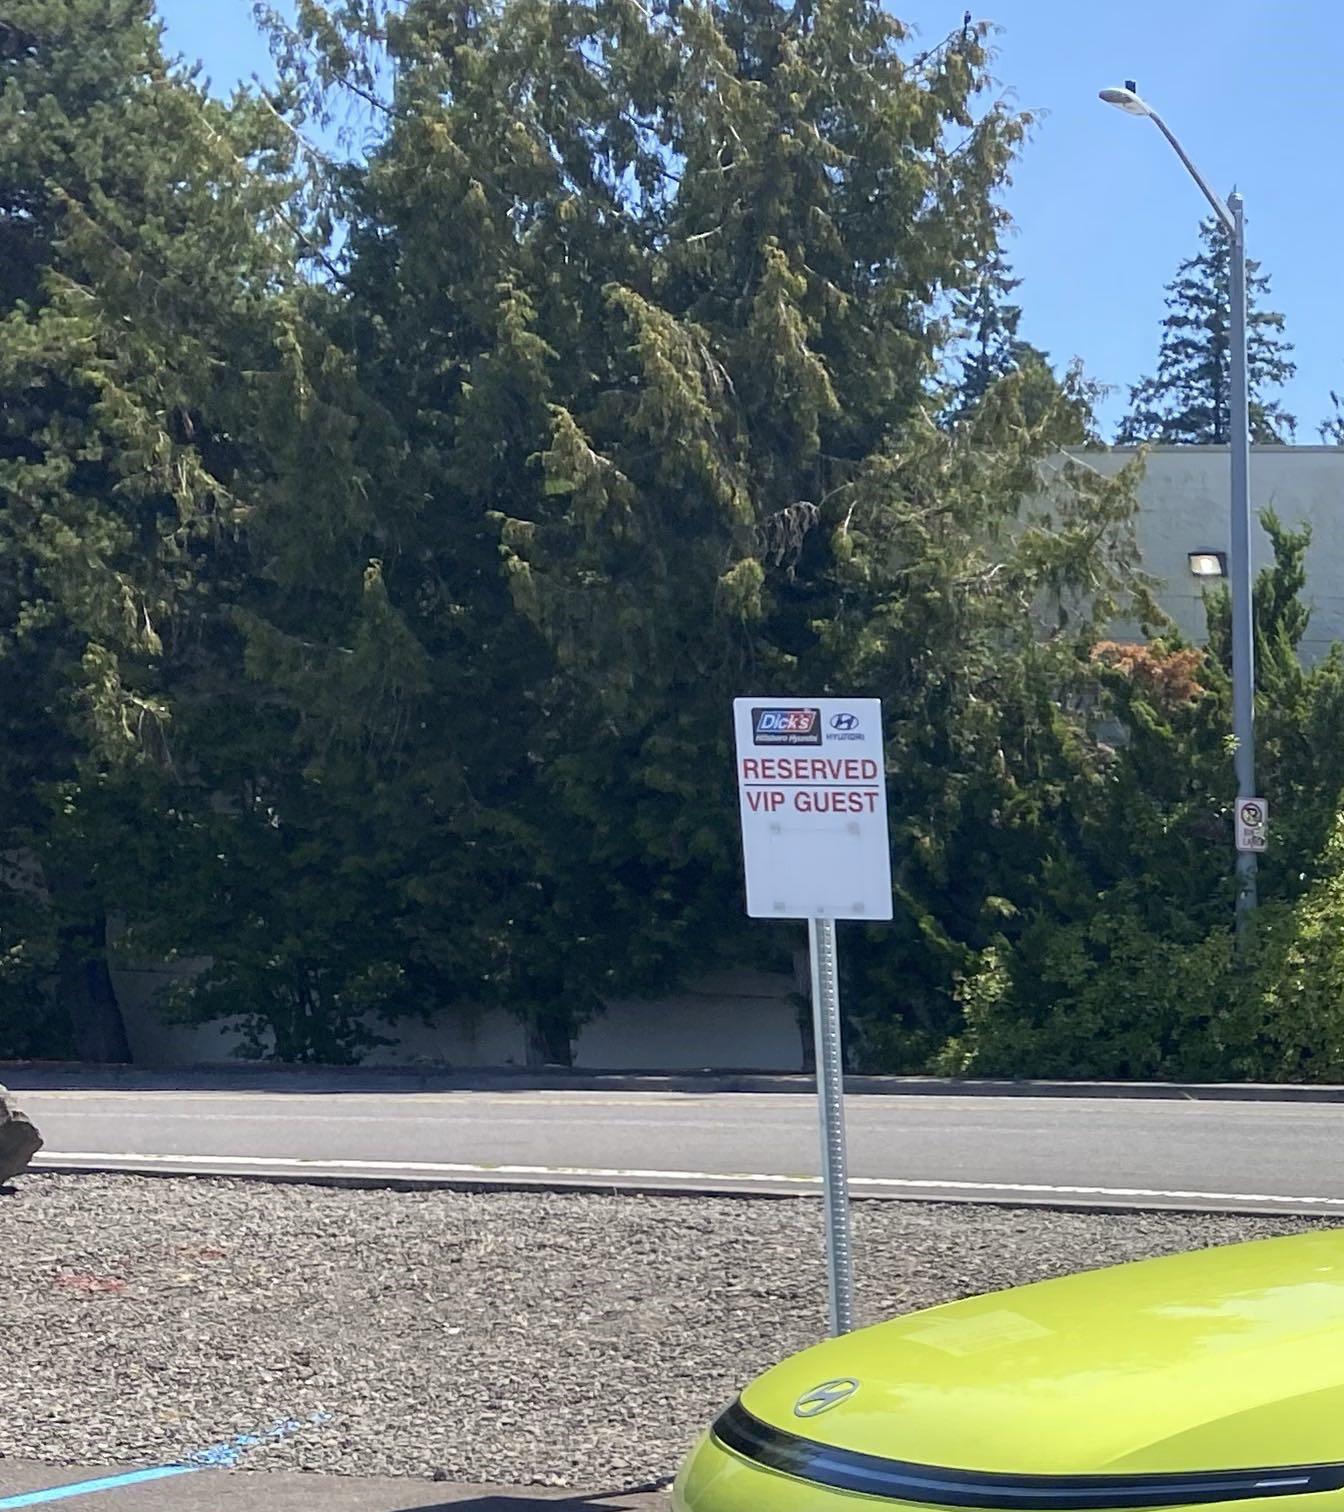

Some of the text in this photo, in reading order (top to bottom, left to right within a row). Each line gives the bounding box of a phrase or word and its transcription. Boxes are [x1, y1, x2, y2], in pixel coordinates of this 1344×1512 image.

[743, 758, 878, 780] RESERVED
[746, 791, 879, 813] VIP GUEST
